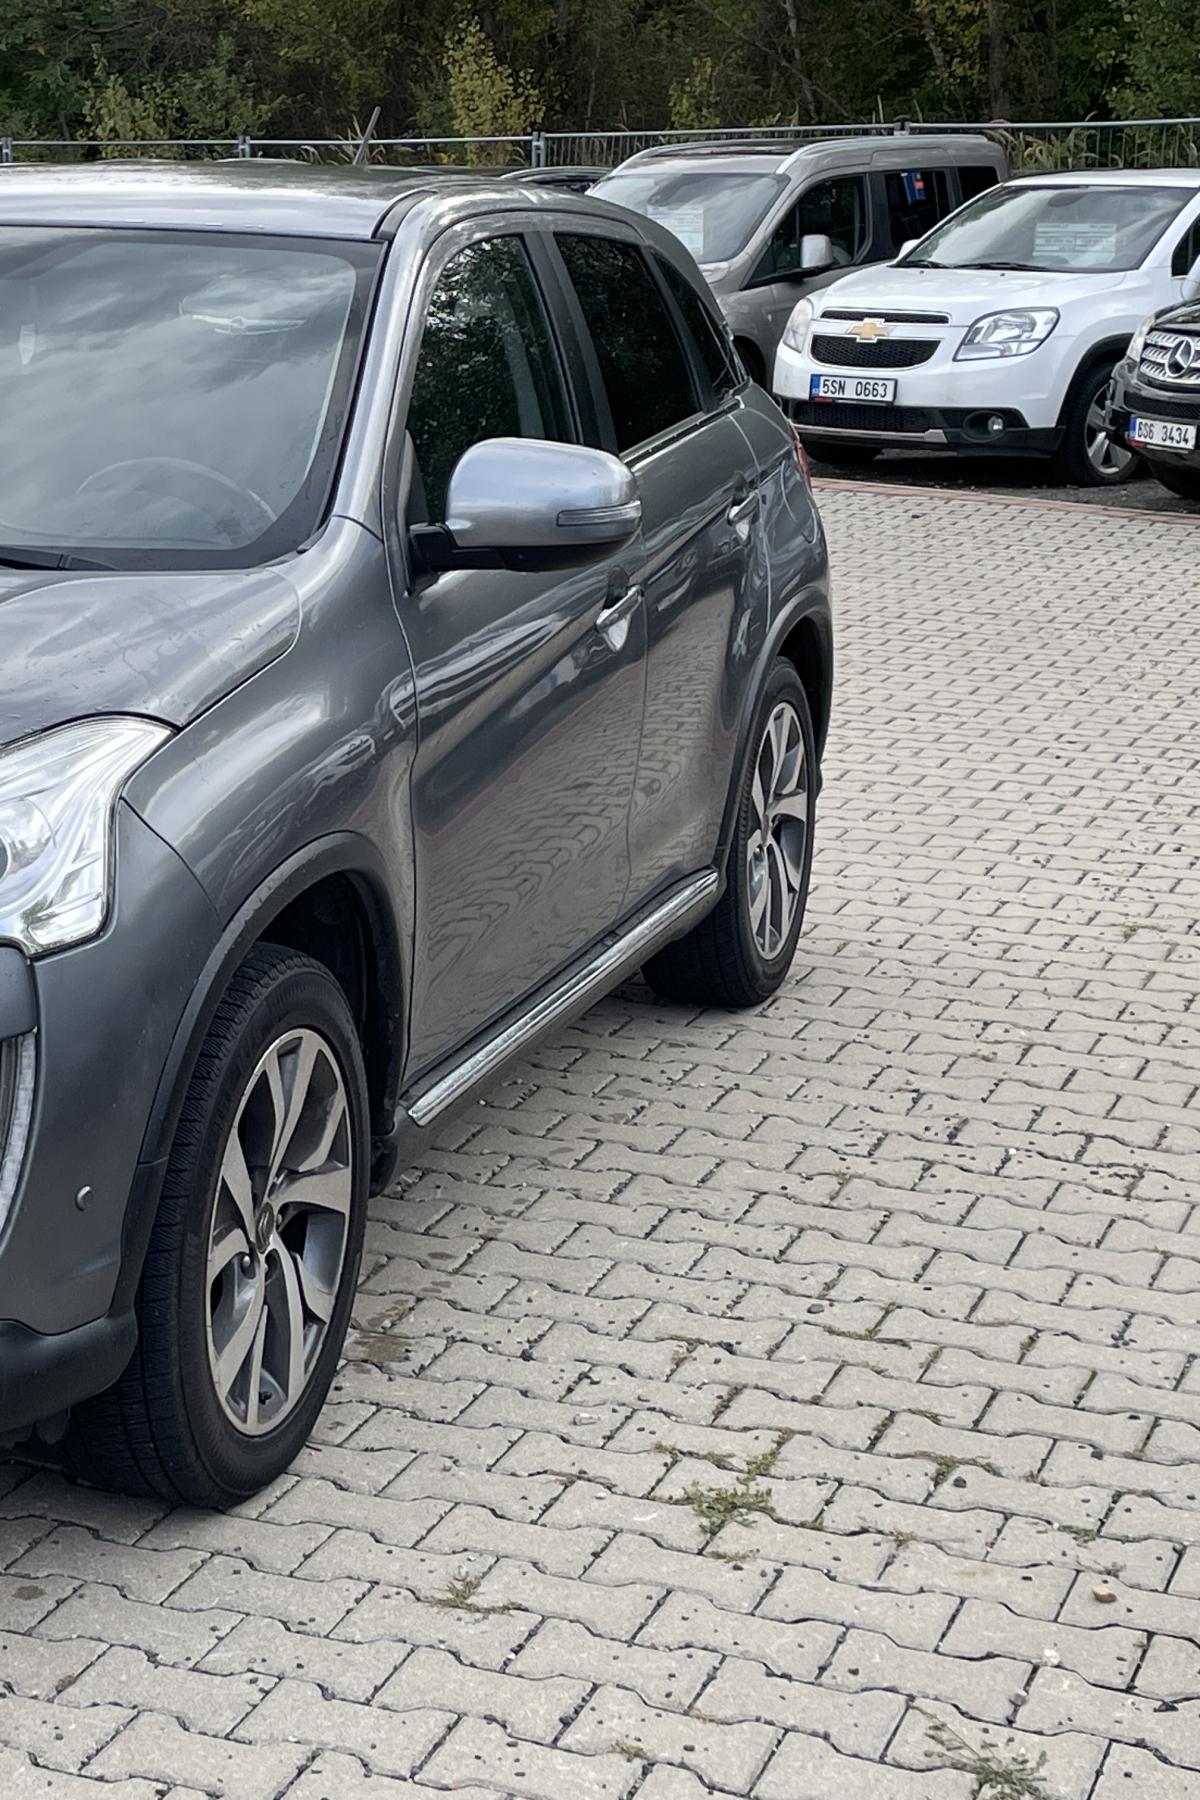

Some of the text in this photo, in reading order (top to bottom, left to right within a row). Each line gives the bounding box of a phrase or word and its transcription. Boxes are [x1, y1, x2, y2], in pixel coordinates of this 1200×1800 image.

[822, 379, 888, 398] 5SN 0663
[1138, 421, 1189, 445] 6S6 3434
